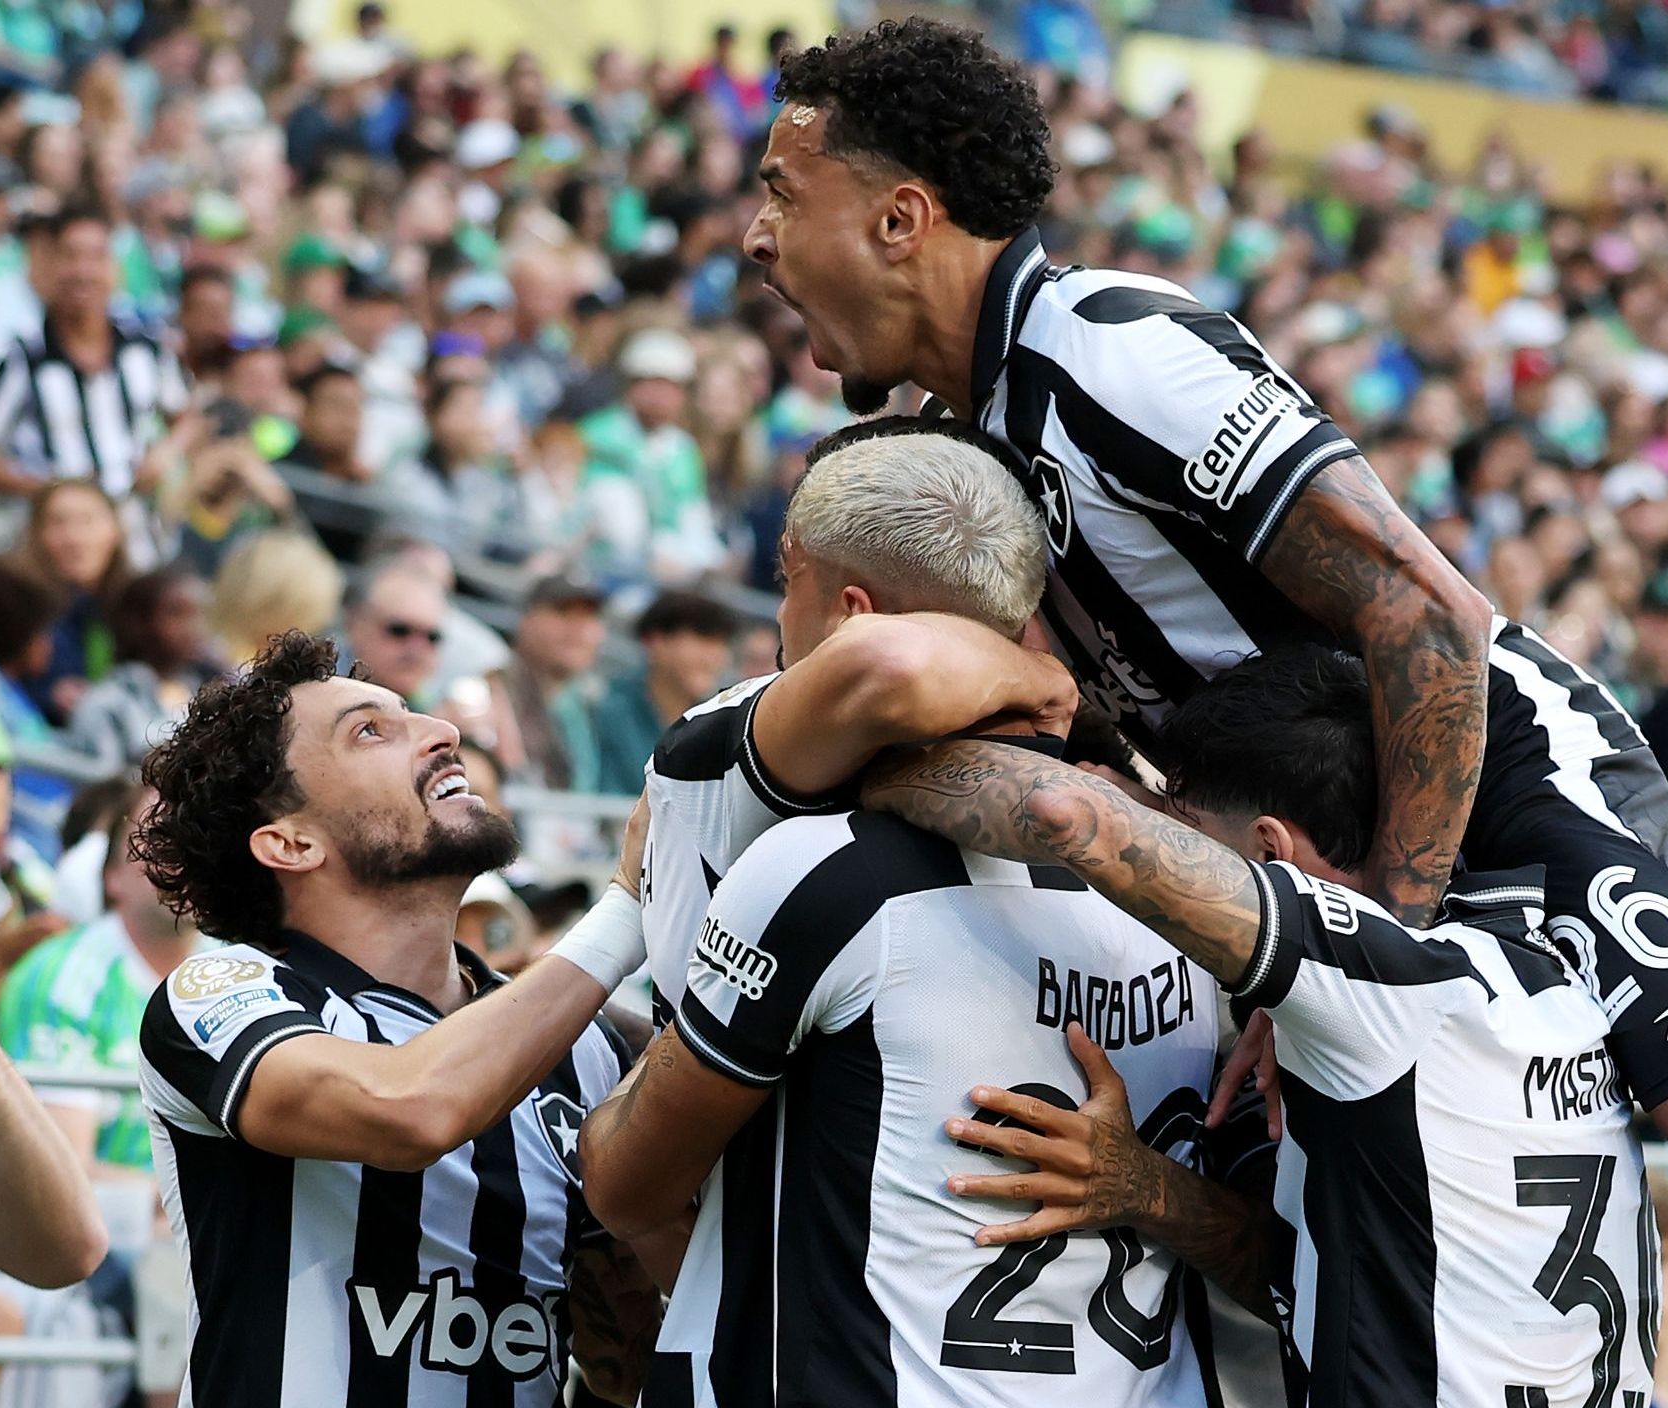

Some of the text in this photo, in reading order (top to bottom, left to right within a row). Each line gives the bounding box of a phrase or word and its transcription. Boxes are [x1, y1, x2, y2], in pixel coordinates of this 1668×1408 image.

[1187, 377, 1283, 497] Centrum
[1081, 653, 1163, 723] bet
[699, 915, 775, 984] ntrum
[1036, 954, 1194, 1051] BARBOZA
[939, 1082, 1209, 1375] 20
